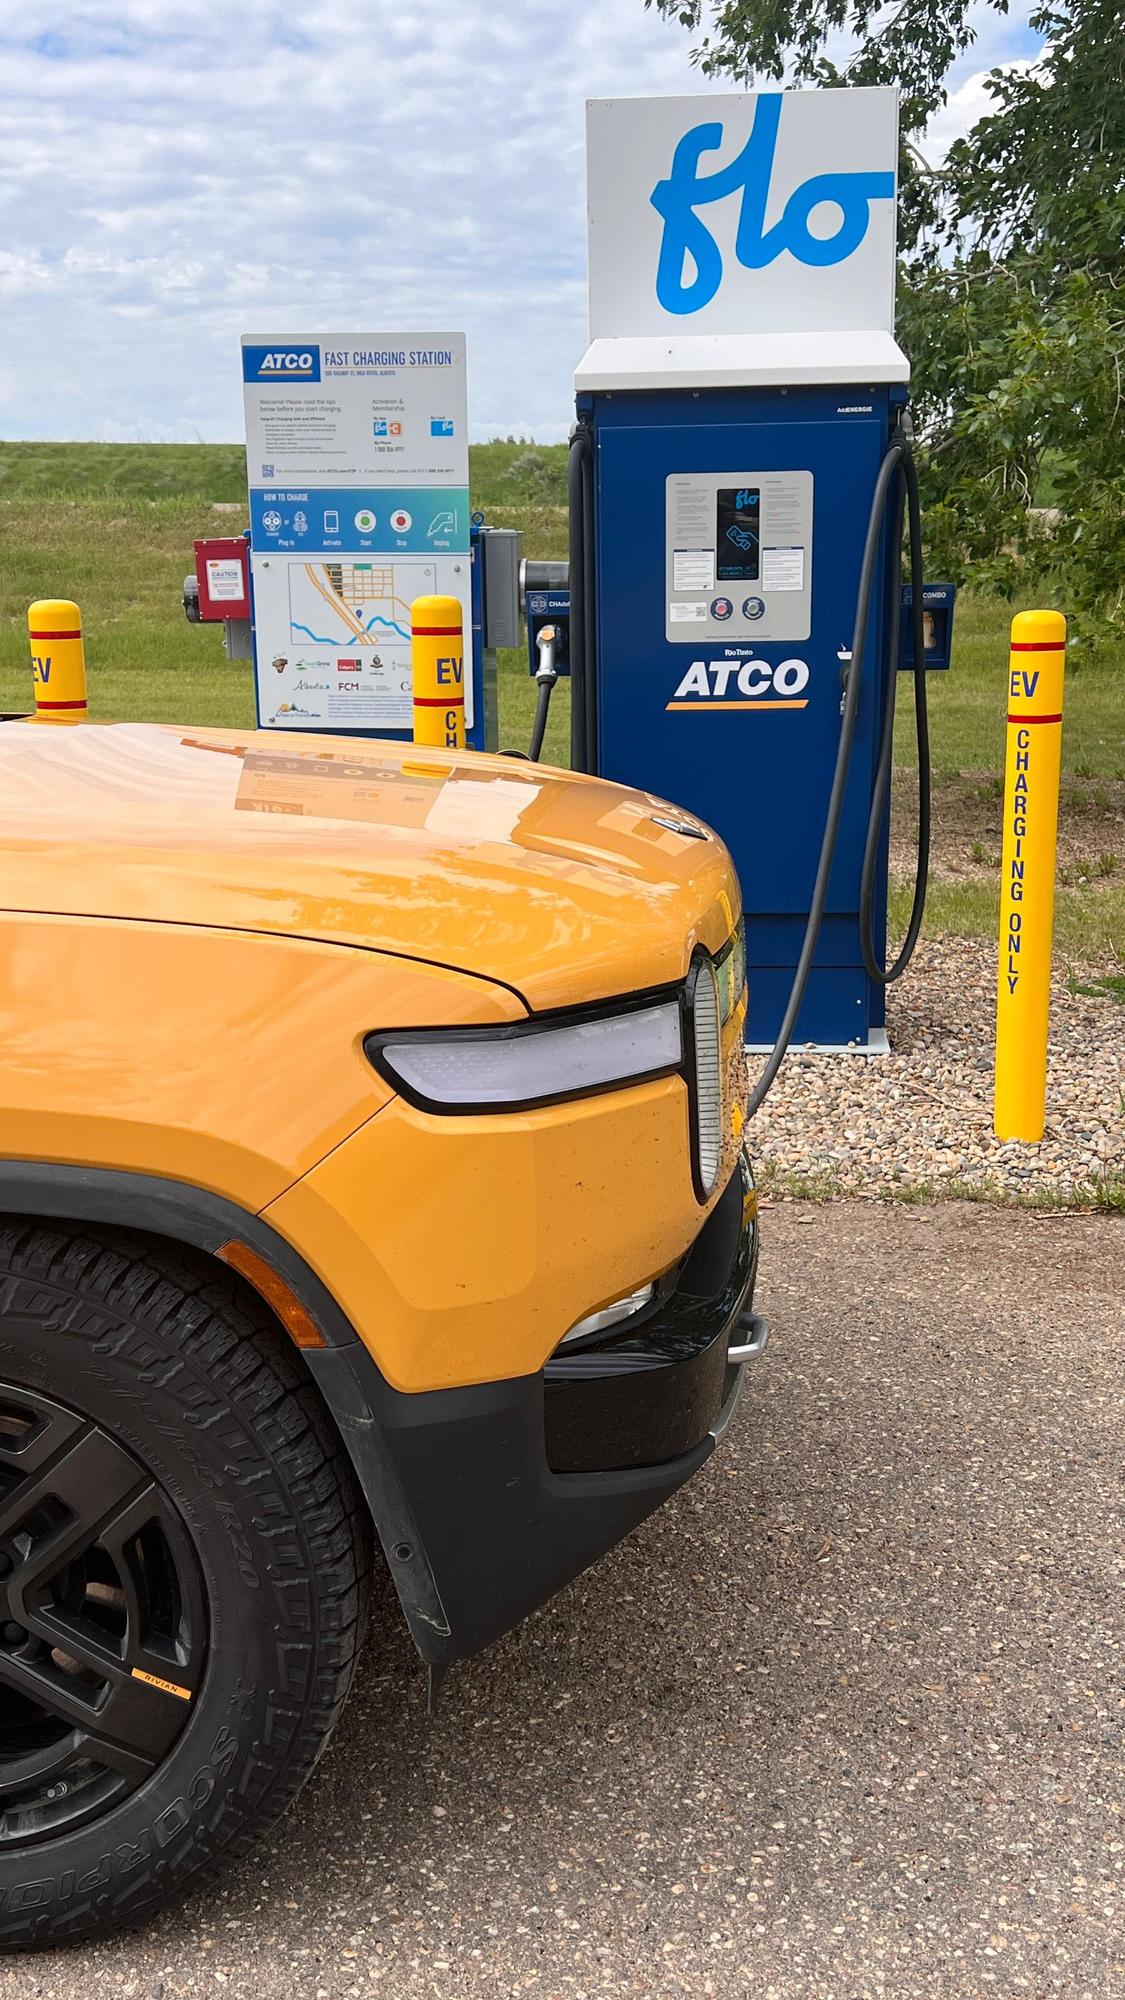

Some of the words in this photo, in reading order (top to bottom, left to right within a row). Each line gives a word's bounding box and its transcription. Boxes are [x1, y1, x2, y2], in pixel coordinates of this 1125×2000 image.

[650, 93, 895, 315] flo
[261, 353, 313, 369] ATCO
[325, 352, 349, 366] FAST
[353, 352, 406, 366] CHARGING
[409, 351, 452, 365] STATION
[264, 493, 276, 501] HOW
[278, 493, 285, 501] TO
[287, 493, 309, 501] CHARGE
[735, 489, 760, 509] flo
[437, 657, 463, 684] EV
[673, 659, 810, 697] ATCO
[339, 683, 359, 691] FCM
[1010, 671, 1040, 697] EV
[1011, 729, 1030, 901] CHARGING
[1008, 913, 1022, 995] ONLY
[144, 1675, 178, 1692] RIVIAN
